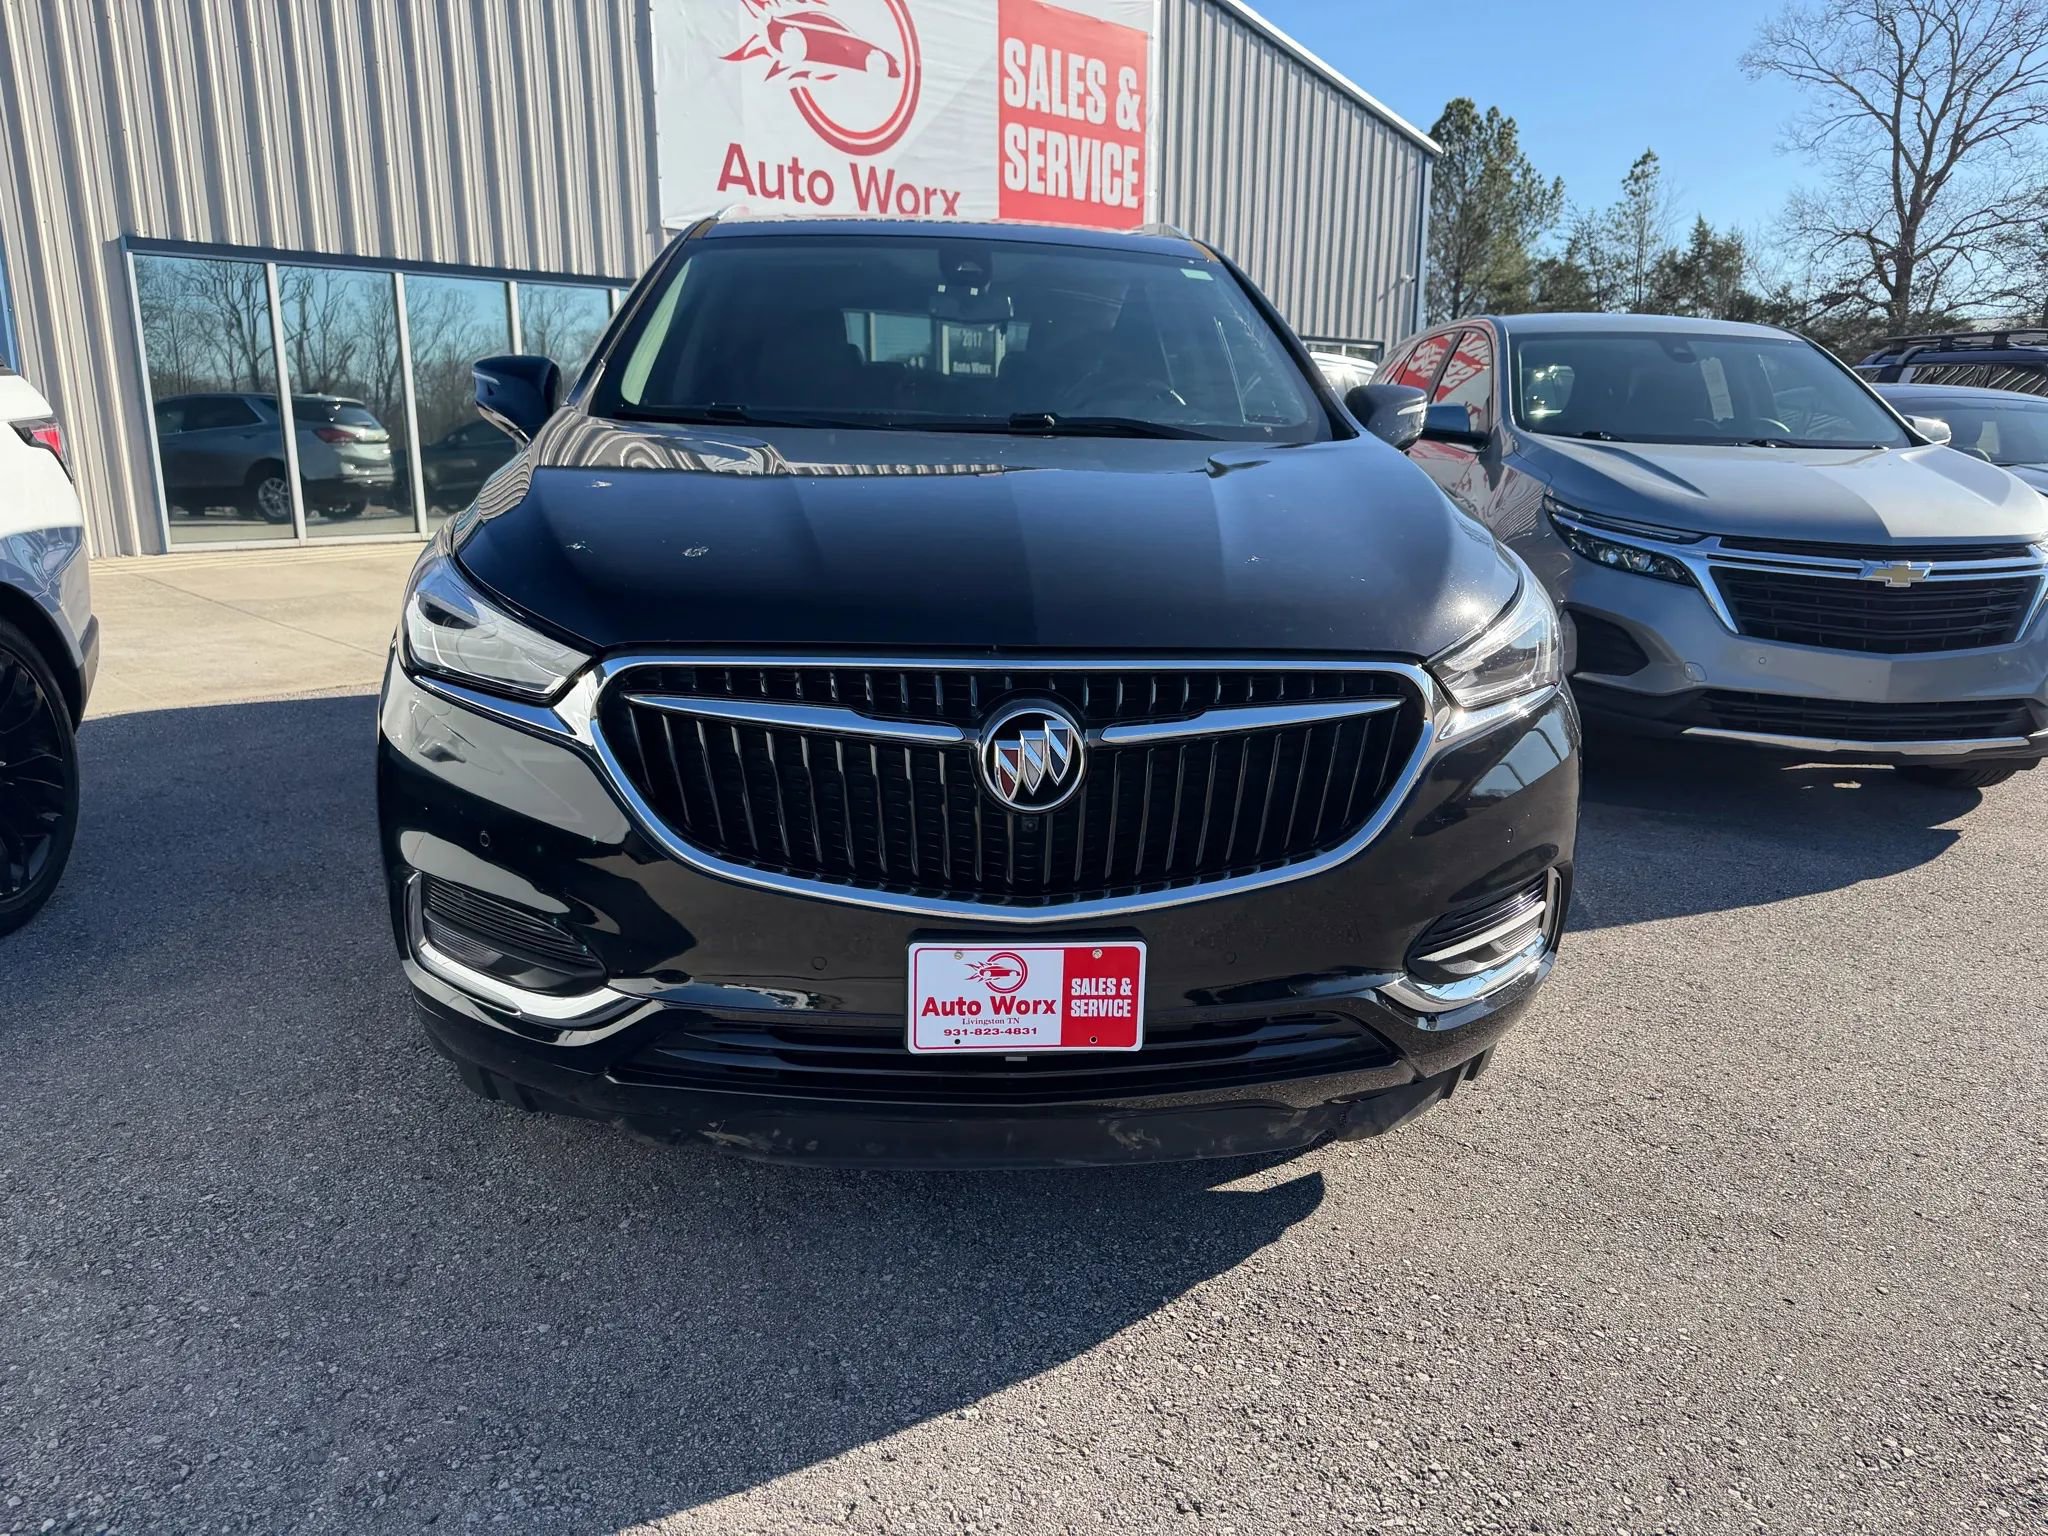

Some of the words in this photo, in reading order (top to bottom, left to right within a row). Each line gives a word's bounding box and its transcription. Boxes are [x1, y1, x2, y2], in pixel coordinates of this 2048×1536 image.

[1003, 37, 1107, 125] SALES
[1116, 66, 1141, 133] &
[1004, 122, 1139, 209] SERVICE
[717, 143, 834, 206] Auto
[849, 162, 960, 216] Worx
[1071, 977, 1116, 996] SALES
[1120, 977, 1132, 996] &
[921, 996, 982, 1017] Auto
[990, 995, 1057, 1015] Worx
[1070, 999, 1132, 1017] SERVICE
[943, 1027, 1037, 1036] 931-823-4831
[962, 1017, 1005, 1026] Livingston
